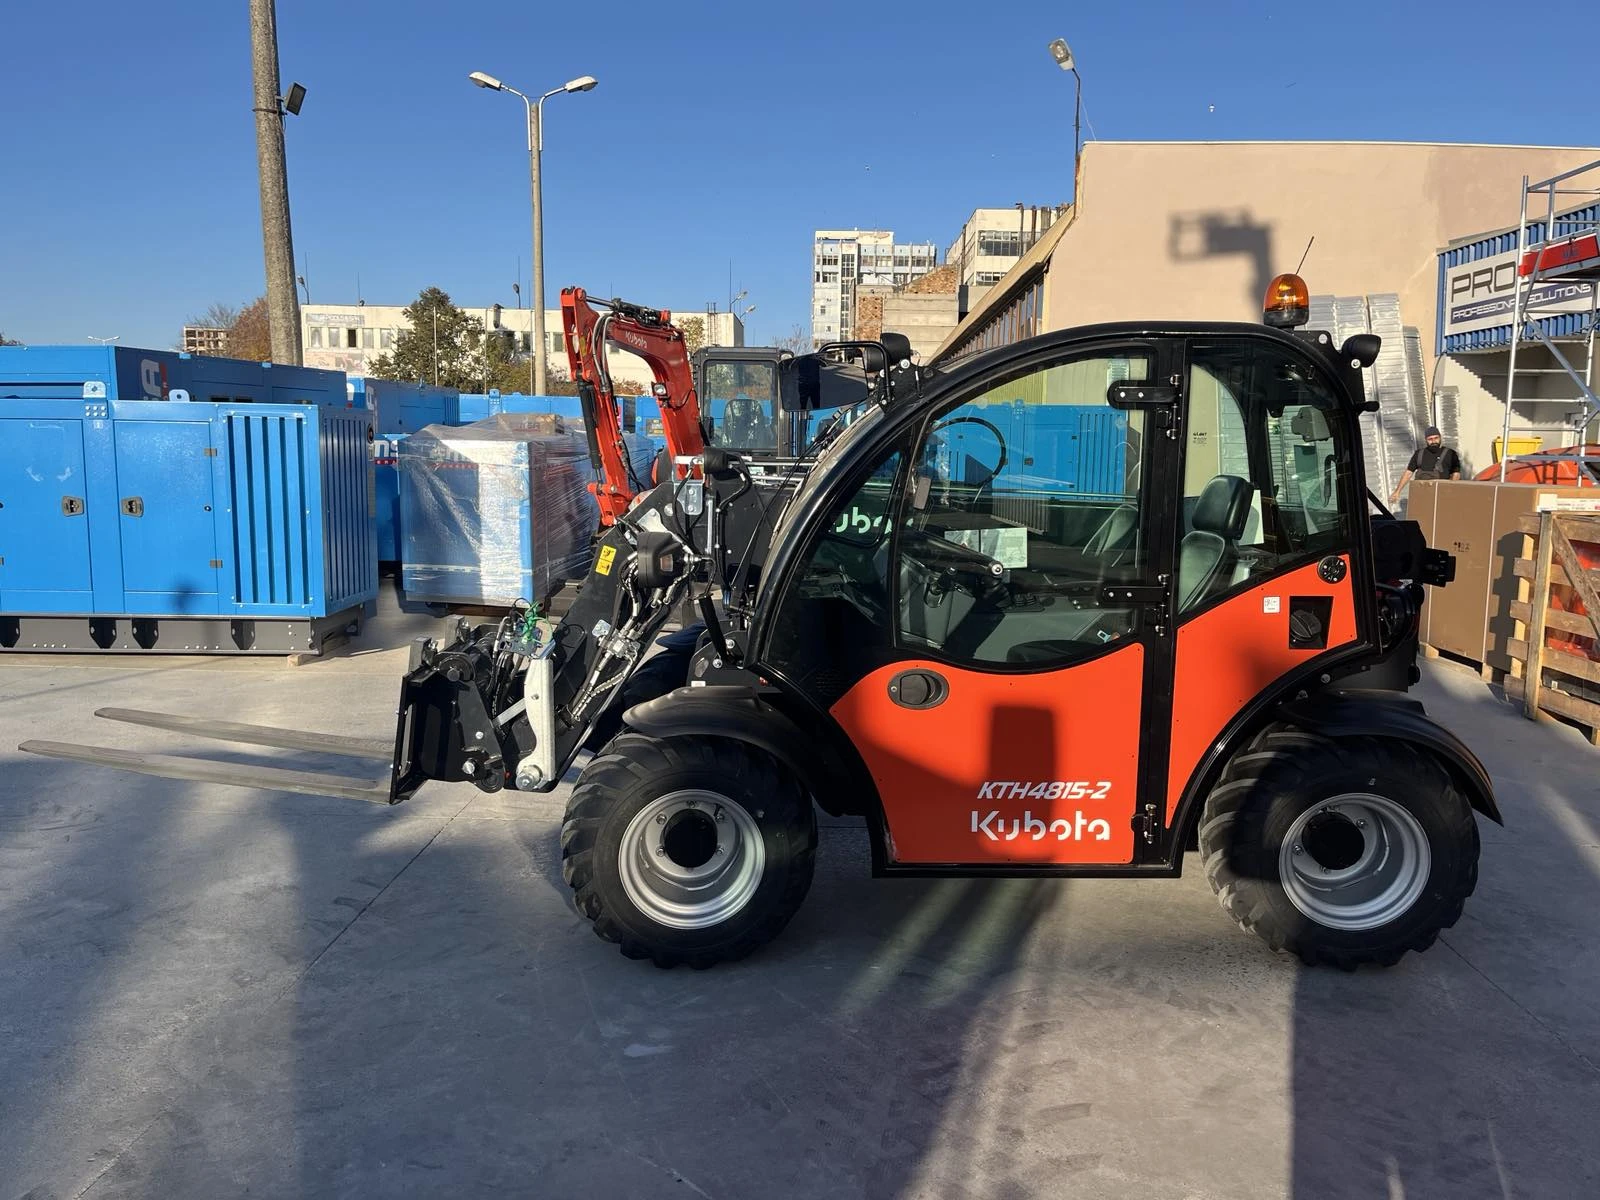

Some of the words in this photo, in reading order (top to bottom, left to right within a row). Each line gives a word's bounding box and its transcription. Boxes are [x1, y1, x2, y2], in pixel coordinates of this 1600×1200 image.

[1451, 261, 1517, 303] PRO
[1527, 284, 1591, 305] SOLUTIONS
[625, 330, 647, 349] Kubota
[976, 781, 1112, 800] KTH4815-2
[970, 810, 1111, 841] Kubota
